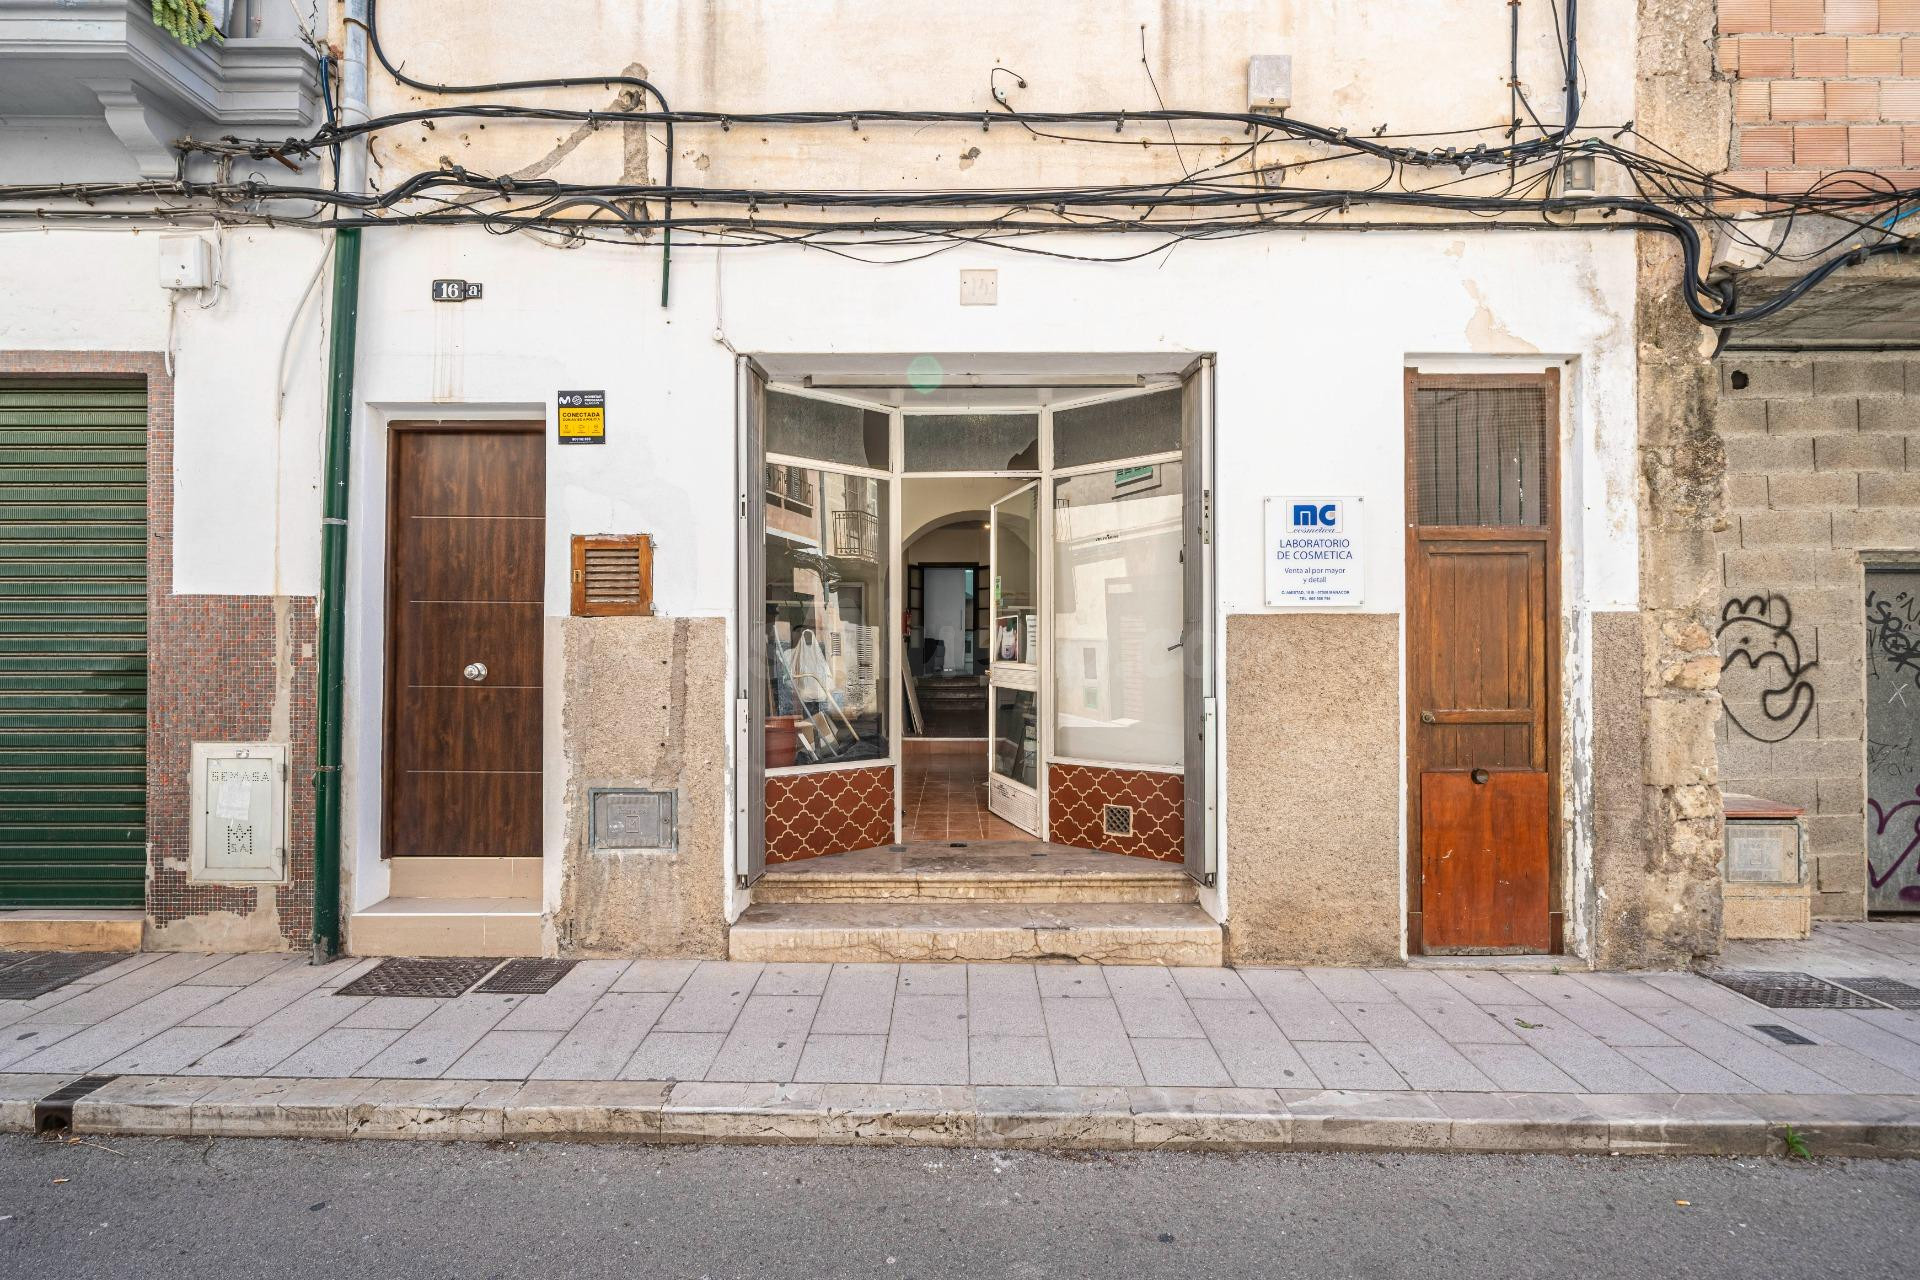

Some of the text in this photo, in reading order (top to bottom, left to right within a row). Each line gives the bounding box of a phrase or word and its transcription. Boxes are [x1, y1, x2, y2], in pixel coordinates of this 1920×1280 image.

[441, 283, 459, 298] 16
[468, 285, 478, 296] a
[1279, 539, 1350, 548] LABORATORIO
[1277, 551, 1353, 560] DE COSMETICA
[212, 771, 270, 782] SEMASA
